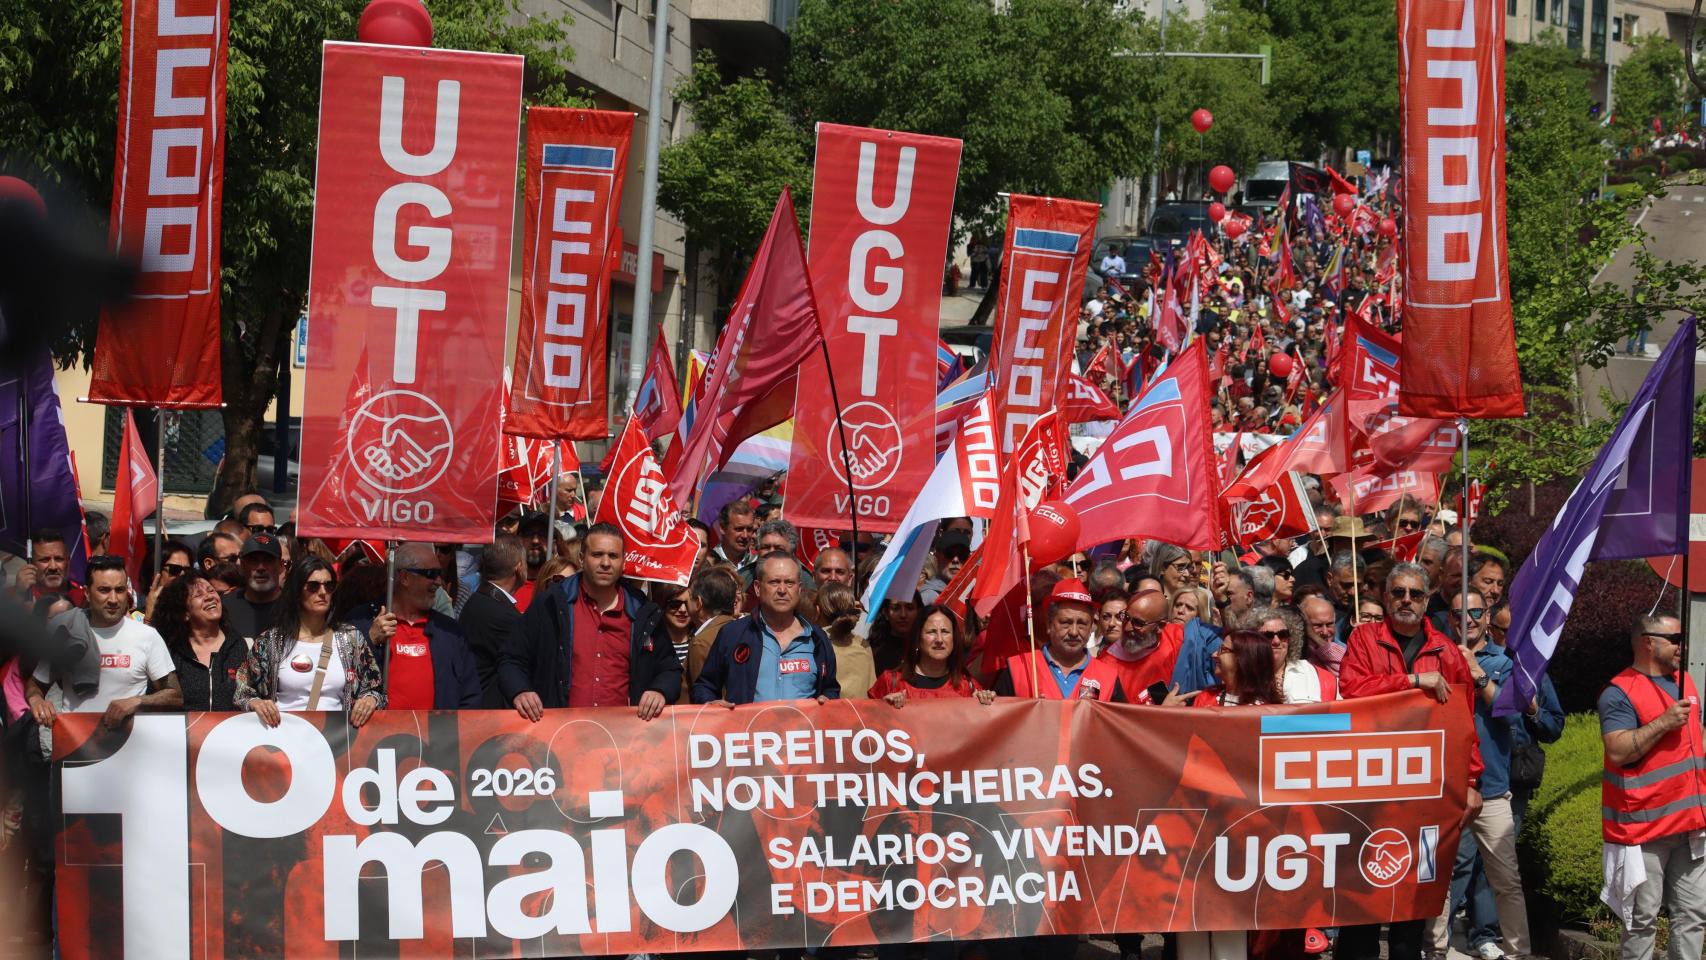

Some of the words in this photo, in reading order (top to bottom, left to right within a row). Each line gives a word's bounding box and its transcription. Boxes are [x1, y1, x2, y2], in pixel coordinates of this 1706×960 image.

[370, 75, 461, 385] UGT
[543, 188, 595, 389] CCOO
[846, 142, 917, 397] UGT
[360, 498, 435, 524] VIGO
[1037, 508, 1066, 525] CCOO
[396, 644, 418, 657] UGT
[780, 662, 801, 671] UGT
[690, 729, 925, 769] DEREITOS,
[1274, 745, 1433, 790] CCOO
[342, 748, 455, 825] de
[471, 766, 556, 798] 2026
[693, 776, 795, 813] NON
[806, 763, 1114, 809] TRINCHEIRAS.
[323, 789, 740, 941] maio
[768, 830, 984, 870] SALARIOS,
[992, 824, 1167, 861] VIVENDA
[1214, 832, 1351, 892] UGT
[771, 882, 796, 916] E
[806, 871, 1082, 915] DEMOCRACIA
